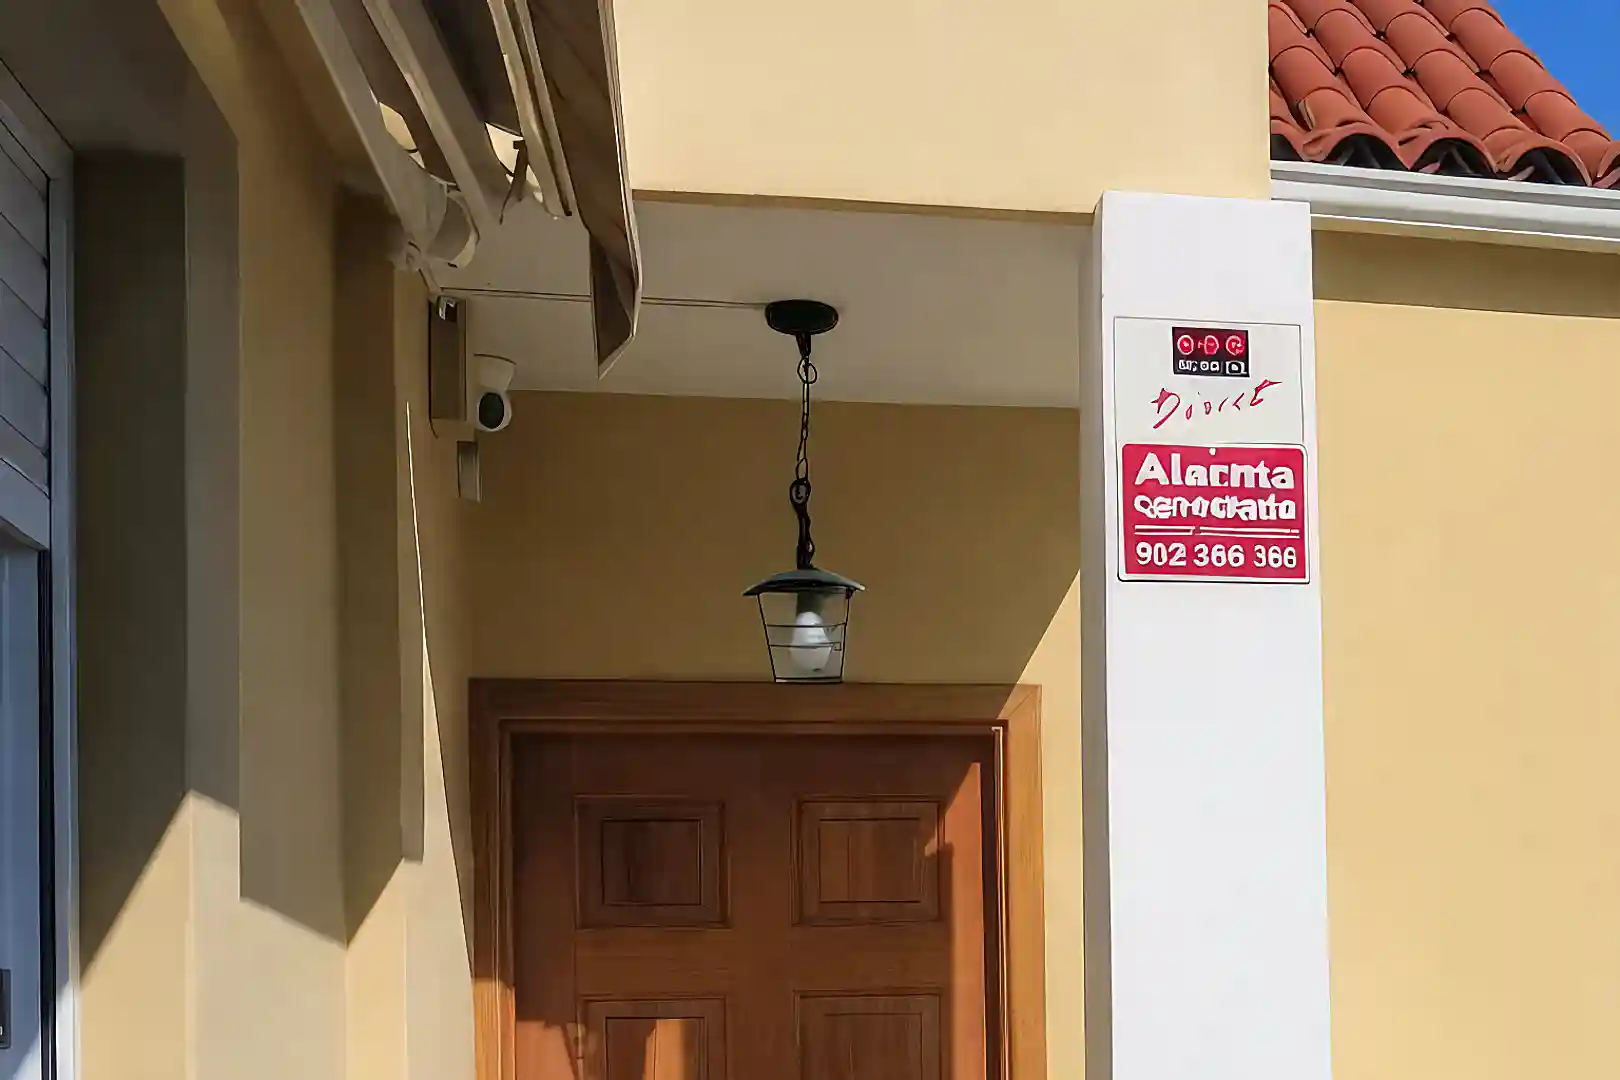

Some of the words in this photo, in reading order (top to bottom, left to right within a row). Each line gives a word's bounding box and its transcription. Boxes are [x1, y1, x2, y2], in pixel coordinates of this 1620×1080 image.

[1136, 541, 1187, 566] 902
[1192, 543, 1245, 567] 366
[1253, 544, 1297, 568] 366
